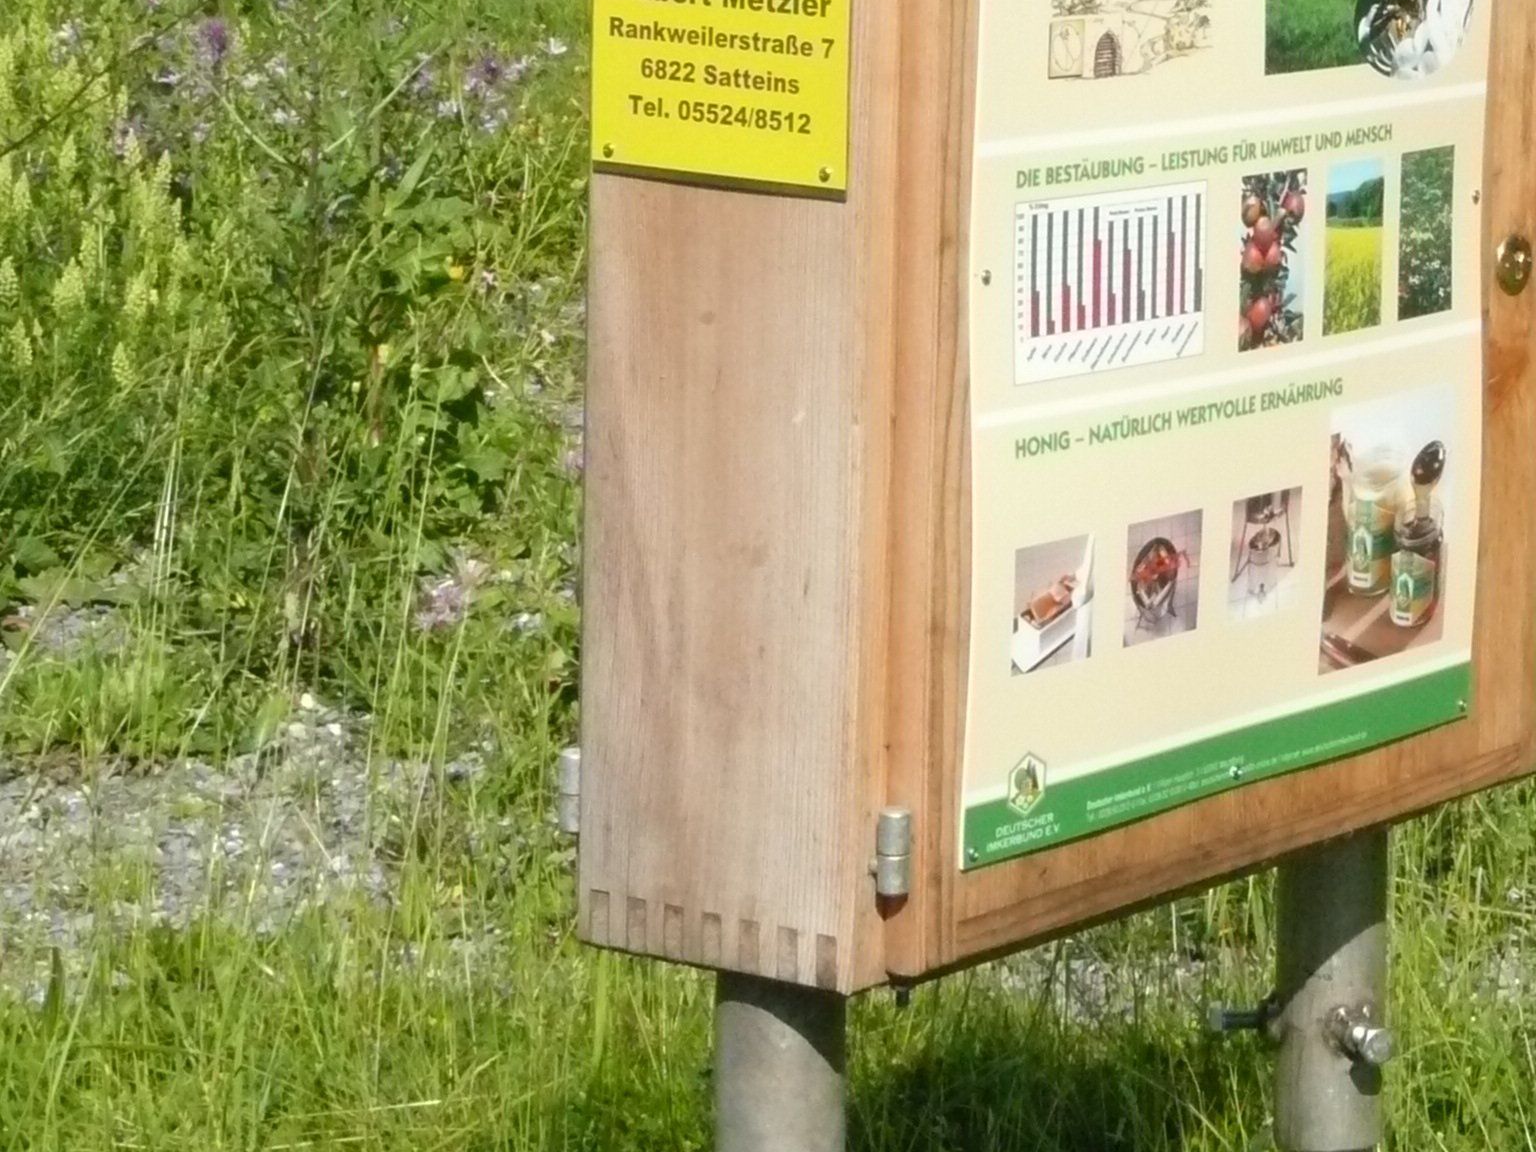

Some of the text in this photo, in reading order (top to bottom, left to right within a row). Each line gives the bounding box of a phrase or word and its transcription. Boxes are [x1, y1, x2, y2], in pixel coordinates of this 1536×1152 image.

[609, 16, 835, 59] Rankweilerstraße 7
[640, 58, 800, 95] 6822 Satteins
[628, 94, 812, 135] Tel. 05524/8512
[1016, 168, 1041, 189] DIE
[1045, 156, 1144, 186] BESTÄUBUNG
[1161, 146, 1228, 171] LEISTUNG
[1232, 139, 1257, 162] FÜR
[1261, 135, 1312, 159] UMWELT
[1315, 131, 1343, 151] UND
[1345, 124, 1392, 147] MENSCH
[1015, 431, 1071, 459] HONIG
[1088, 411, 1172, 446] NATÜRLICH
[1176, 395, 1257, 426] WERTVOLLE
[1260, 377, 1344, 412] ERNÄHRUNG
[995, 812, 1054, 838] DEUTSCHER
